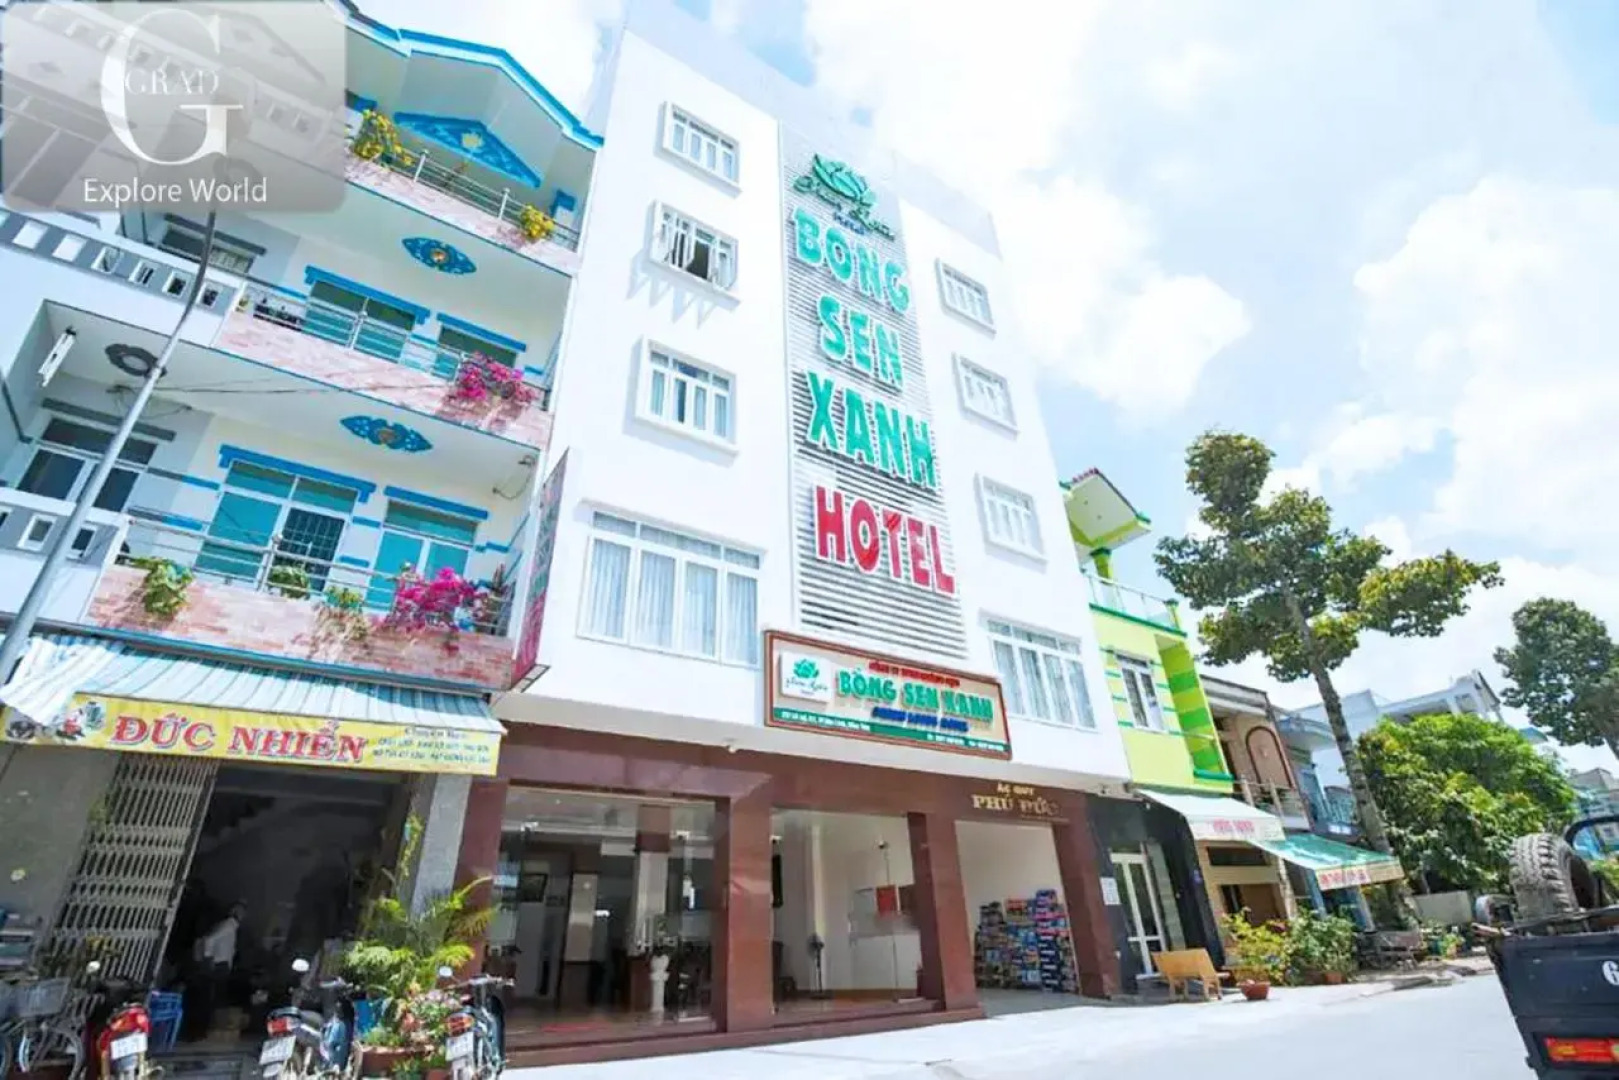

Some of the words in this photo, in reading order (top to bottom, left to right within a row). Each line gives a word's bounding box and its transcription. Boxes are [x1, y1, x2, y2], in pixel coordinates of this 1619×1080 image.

[817, 294, 904, 390] SEN
[806, 370, 937, 489] XANH
[814, 484, 956, 597] HOTEL
[902, 681, 940, 711] SEN
